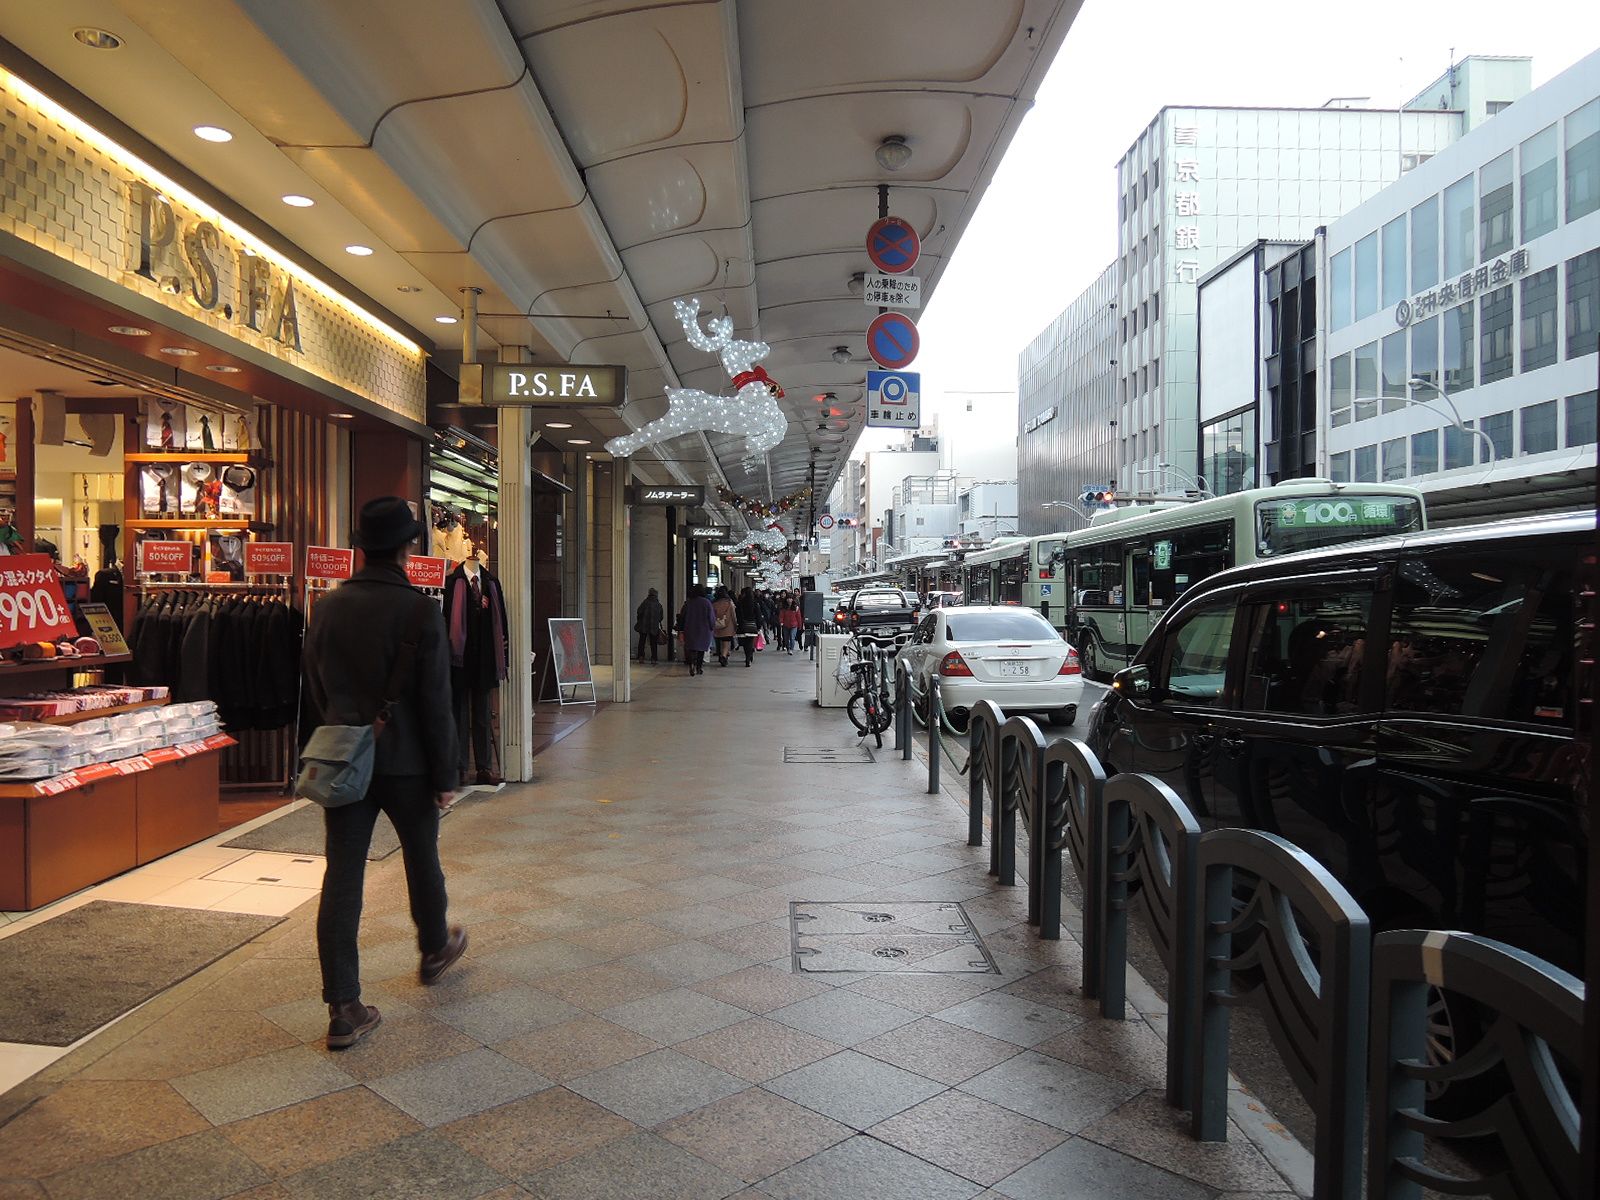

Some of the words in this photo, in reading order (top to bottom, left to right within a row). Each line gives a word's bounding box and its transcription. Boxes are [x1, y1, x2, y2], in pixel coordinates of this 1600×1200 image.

[1175, 159, 1200, 284] 京都銀行
[125, 179, 305, 355] P.S.FA
[866, 277, 918, 292] 人の乗降のため
[866, 291, 910, 304] の停車を除く
[508, 372, 598, 397] P.S.FA
[870, 409, 917, 421] 車輪止め
[645, 491, 696, 500] ノムラテーラー
[148, 553, 185, 561] 50%OFF
[251, 554, 286, 562] 50%OFF
[310, 552, 349, 563] 特価コート
[311, 562, 348, 572] 10,000円
